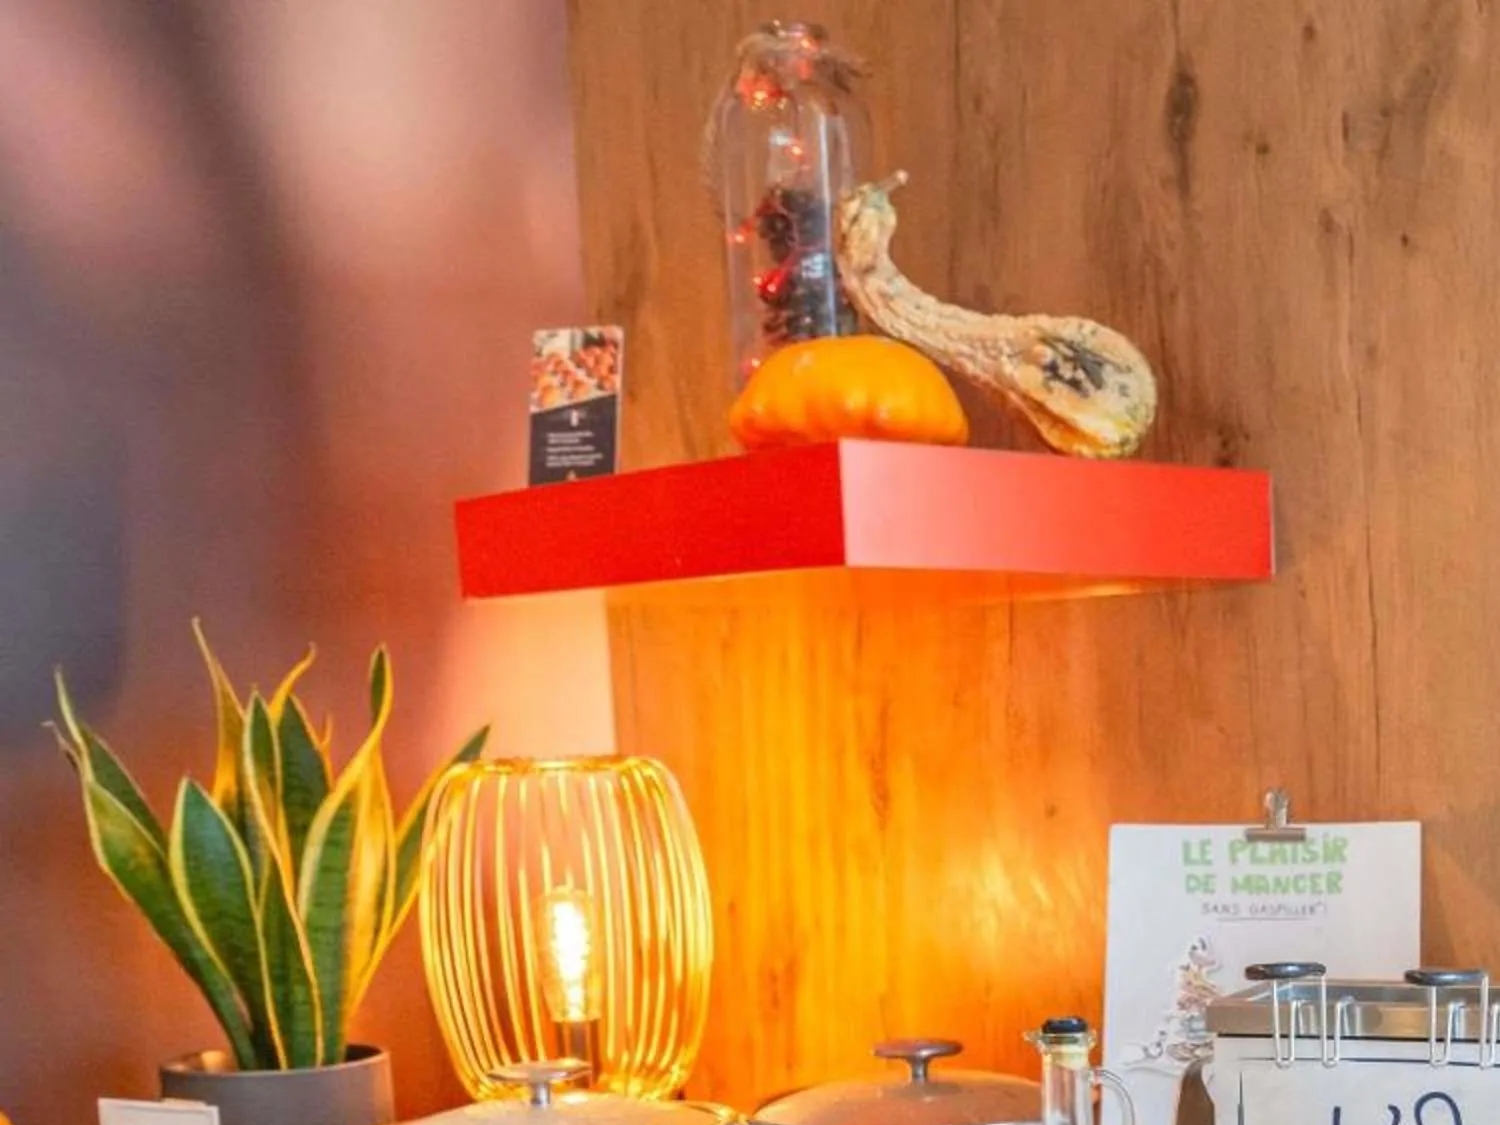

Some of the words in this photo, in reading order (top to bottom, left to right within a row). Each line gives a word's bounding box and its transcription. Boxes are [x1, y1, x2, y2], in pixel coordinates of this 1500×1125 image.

[1182, 838, 1213, 866] LE
[1228, 834, 1348, 866] PLAISIR
[1185, 872, 1217, 895] DE
